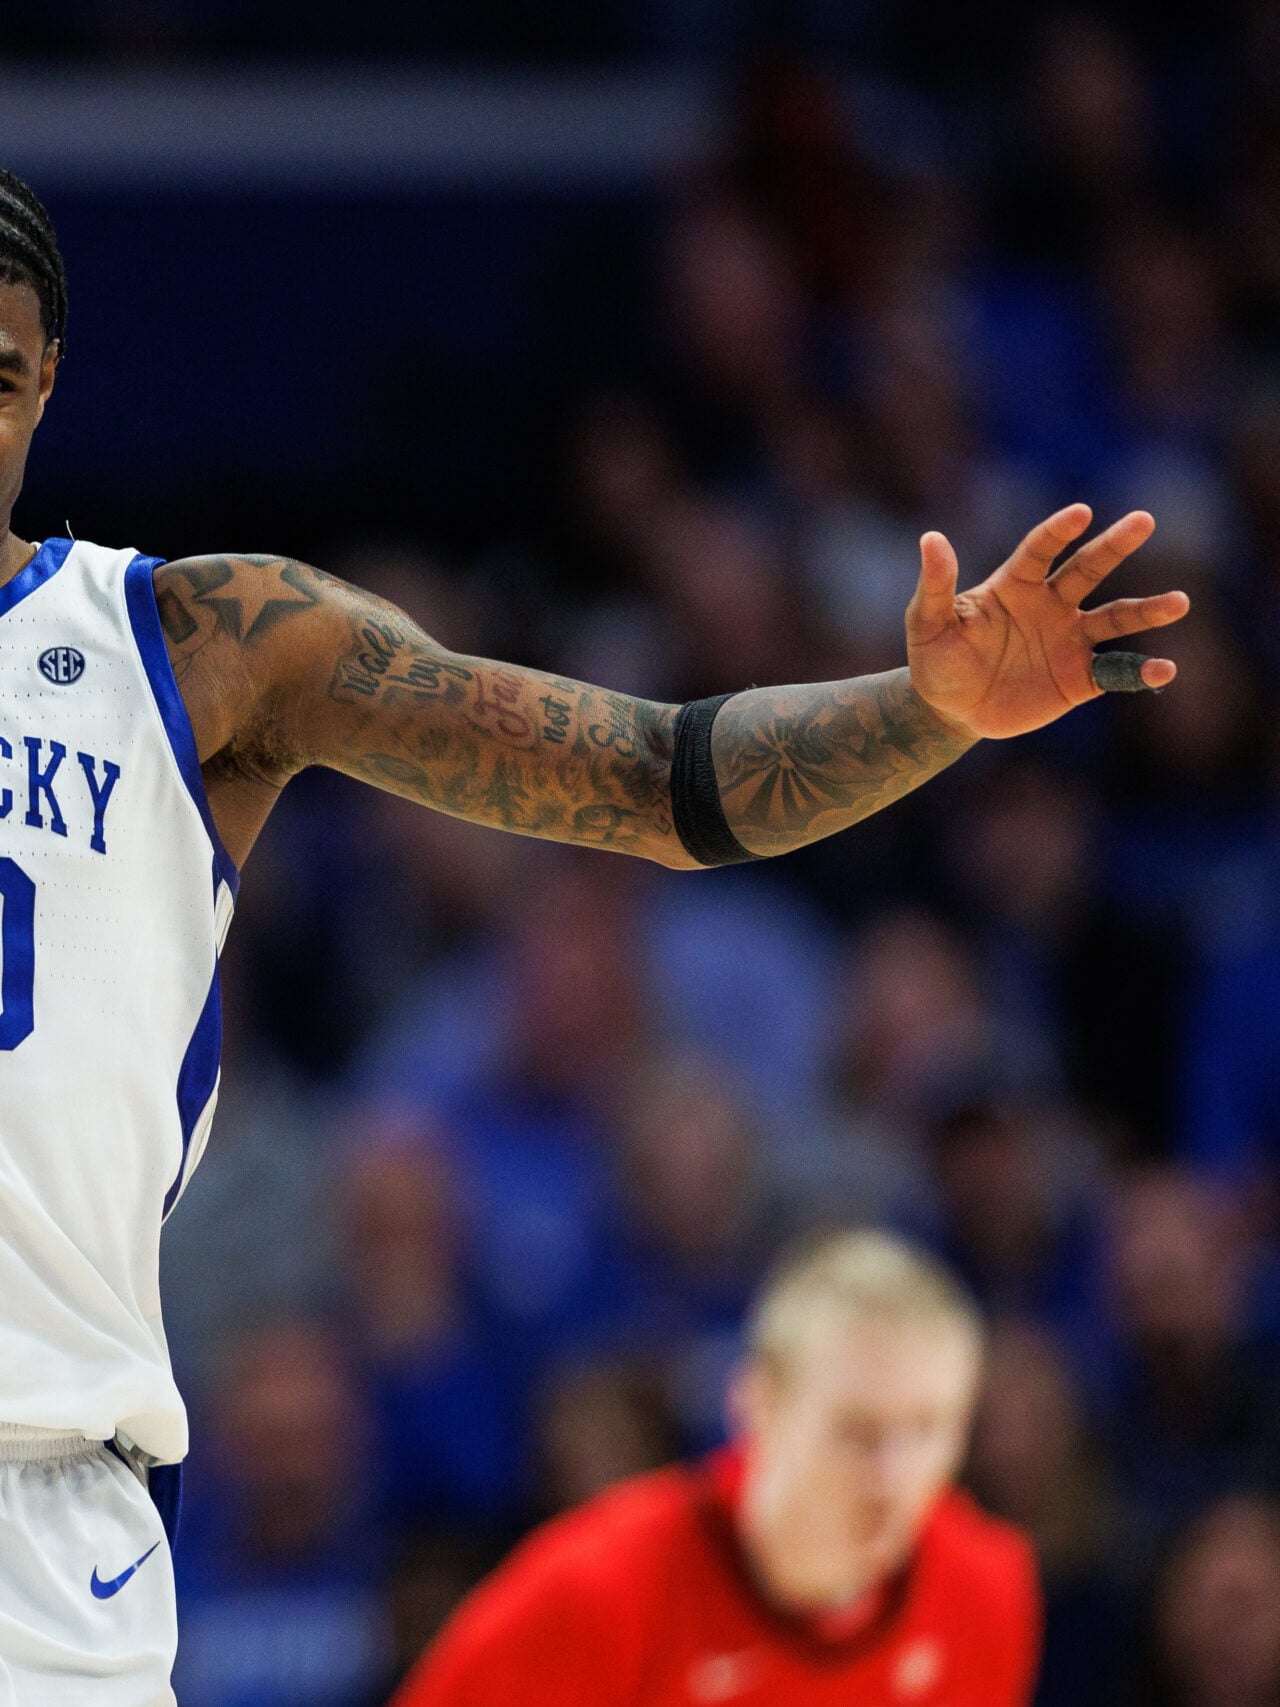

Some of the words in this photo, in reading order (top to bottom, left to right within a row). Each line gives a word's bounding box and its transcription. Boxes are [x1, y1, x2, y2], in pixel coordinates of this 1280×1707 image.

[41, 648, 82, 682] SEC
[341, 618, 405, 697] Walk
[539, 694, 571, 745] not
